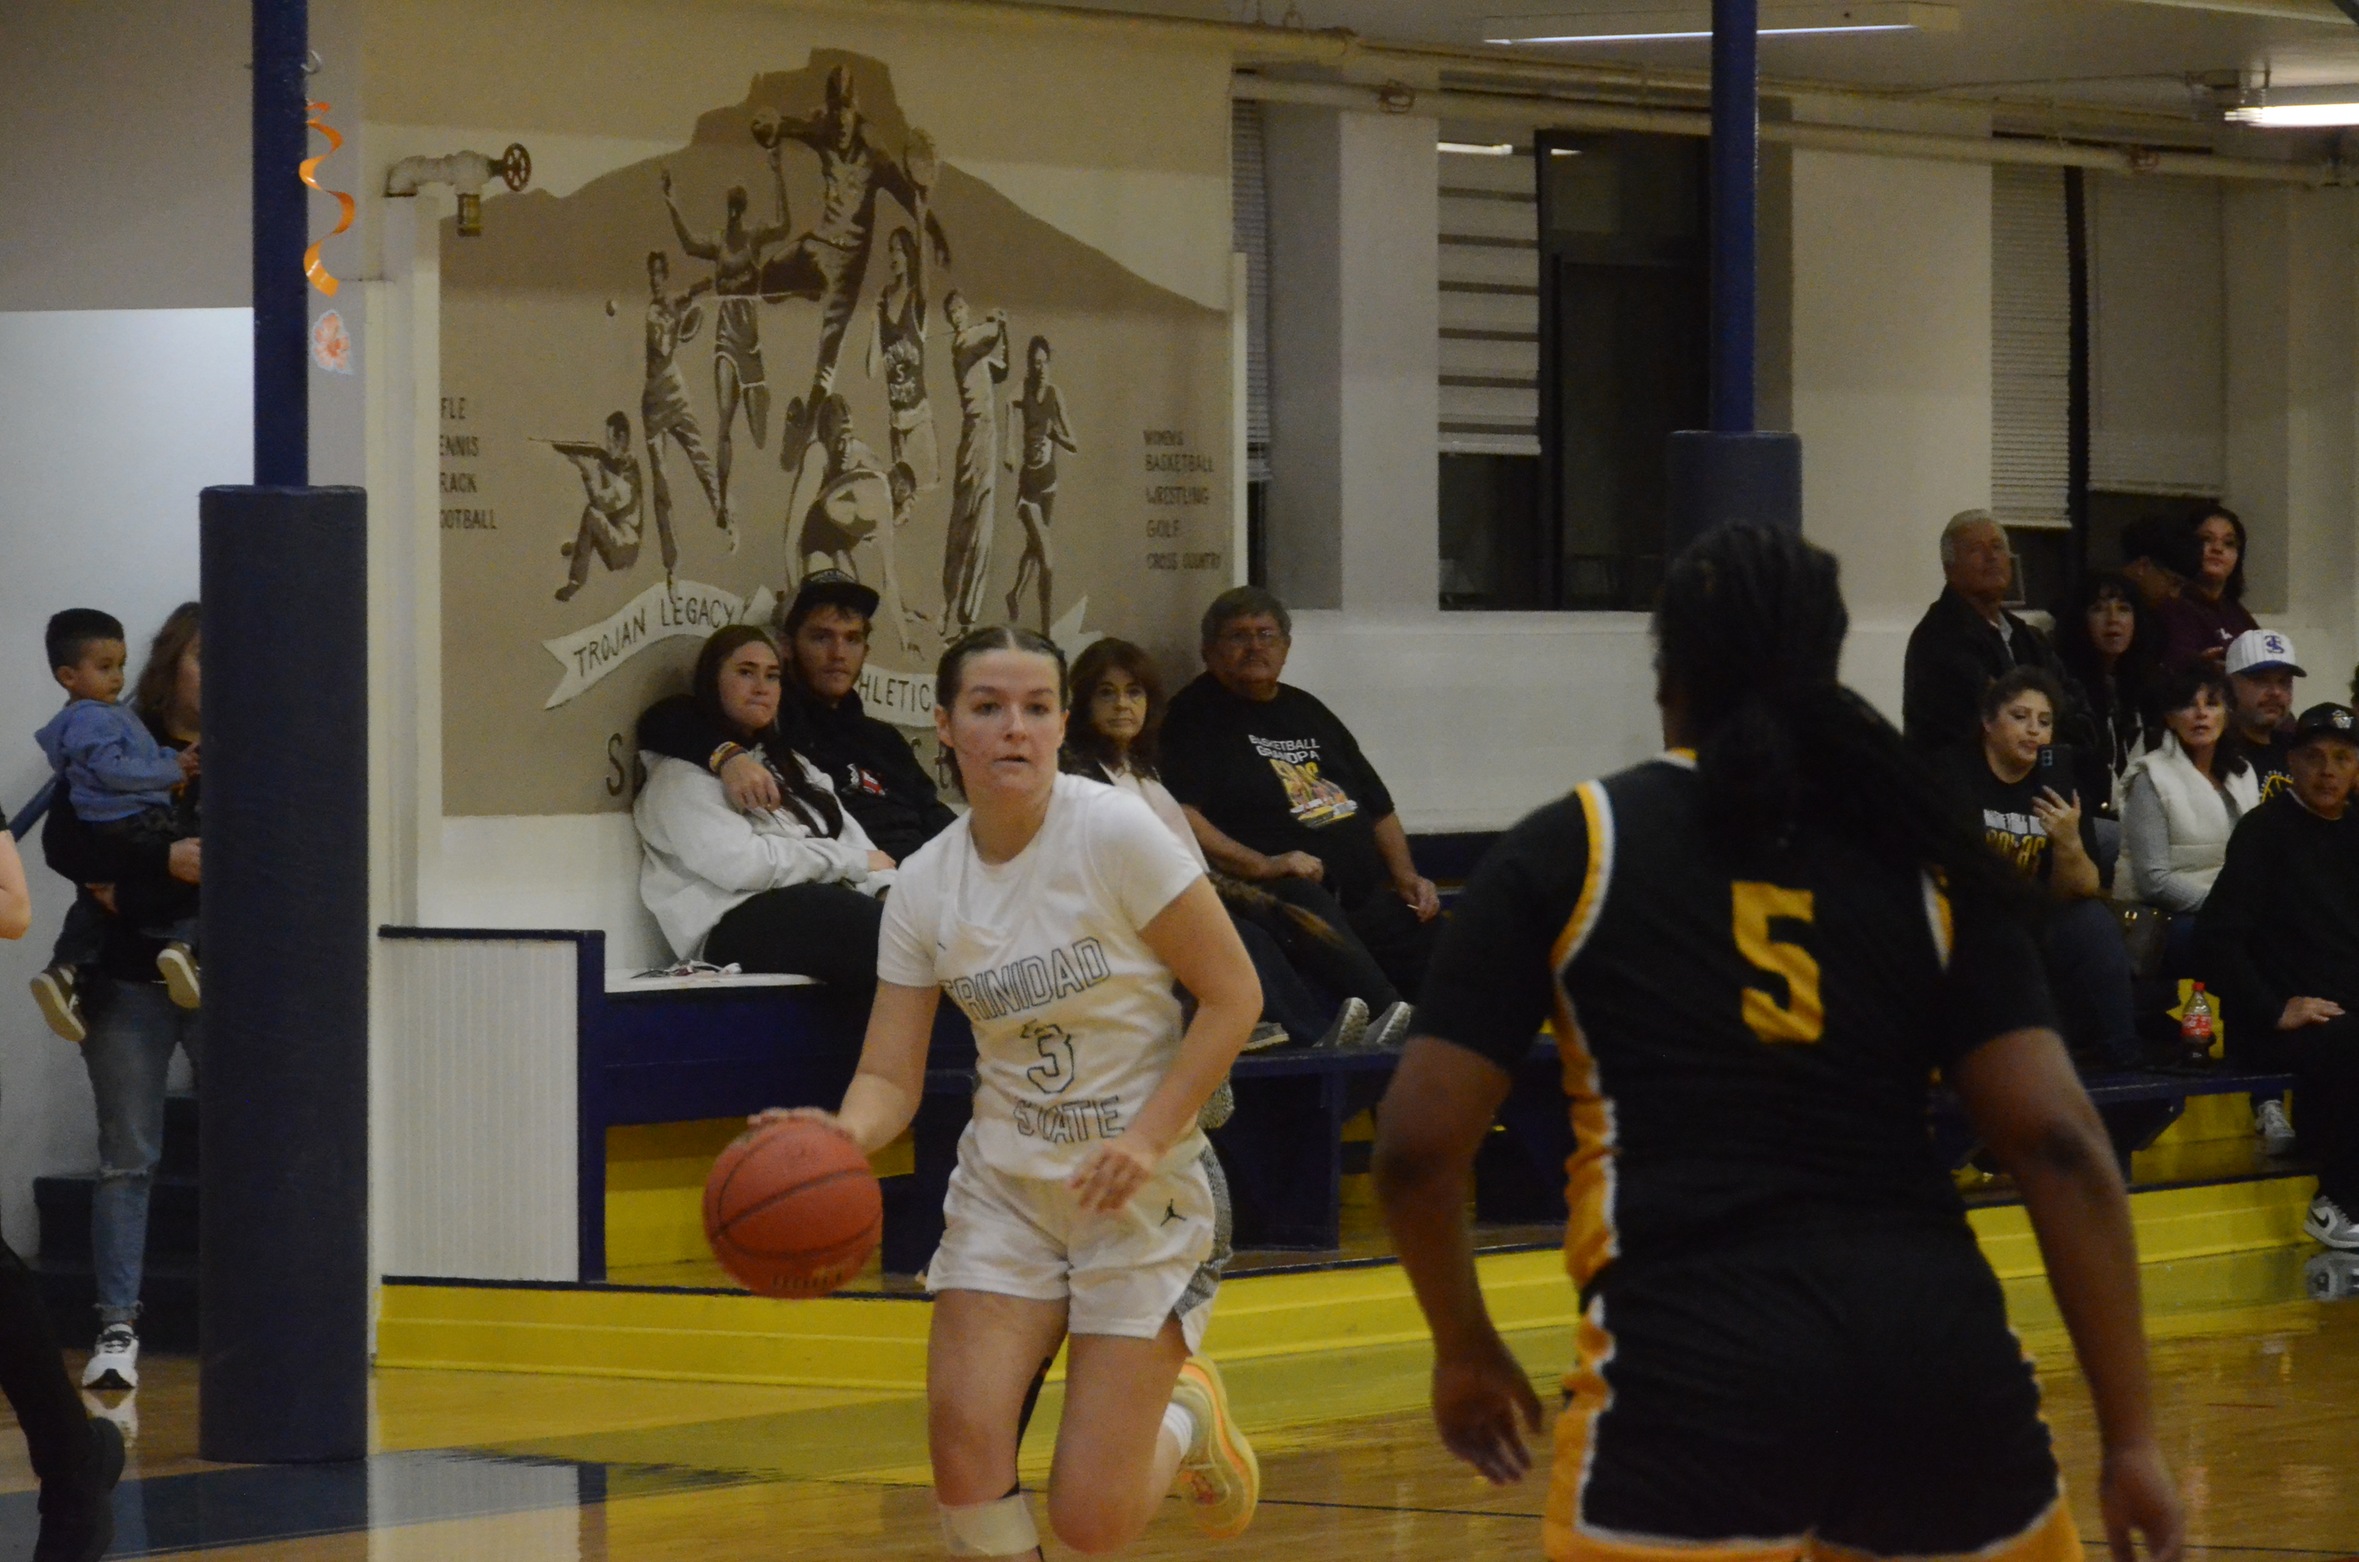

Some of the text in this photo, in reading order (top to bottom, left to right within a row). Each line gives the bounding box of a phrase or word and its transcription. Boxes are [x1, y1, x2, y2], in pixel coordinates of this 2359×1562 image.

[440, 397, 466, 420] FLE
[440, 435, 479, 457] ENNIS
[1144, 454, 1214, 473] BASKETBALL
[440, 472, 478, 493] RACK
[1146, 486, 1209, 504] WRESTLING
[440, 509, 498, 529] OOTBALL
[1146, 519, 1180, 538] GOLF
[1146, 552, 1220, 570] CROSS COUNTRY
[573, 597, 735, 677] TROJAN LEGACY
[858, 673, 933, 712] HLETIC
[1731, 880, 1825, 1043] 5
[1022, 1021, 1075, 1095] 3
[1013, 1094, 1126, 1144] STATE
